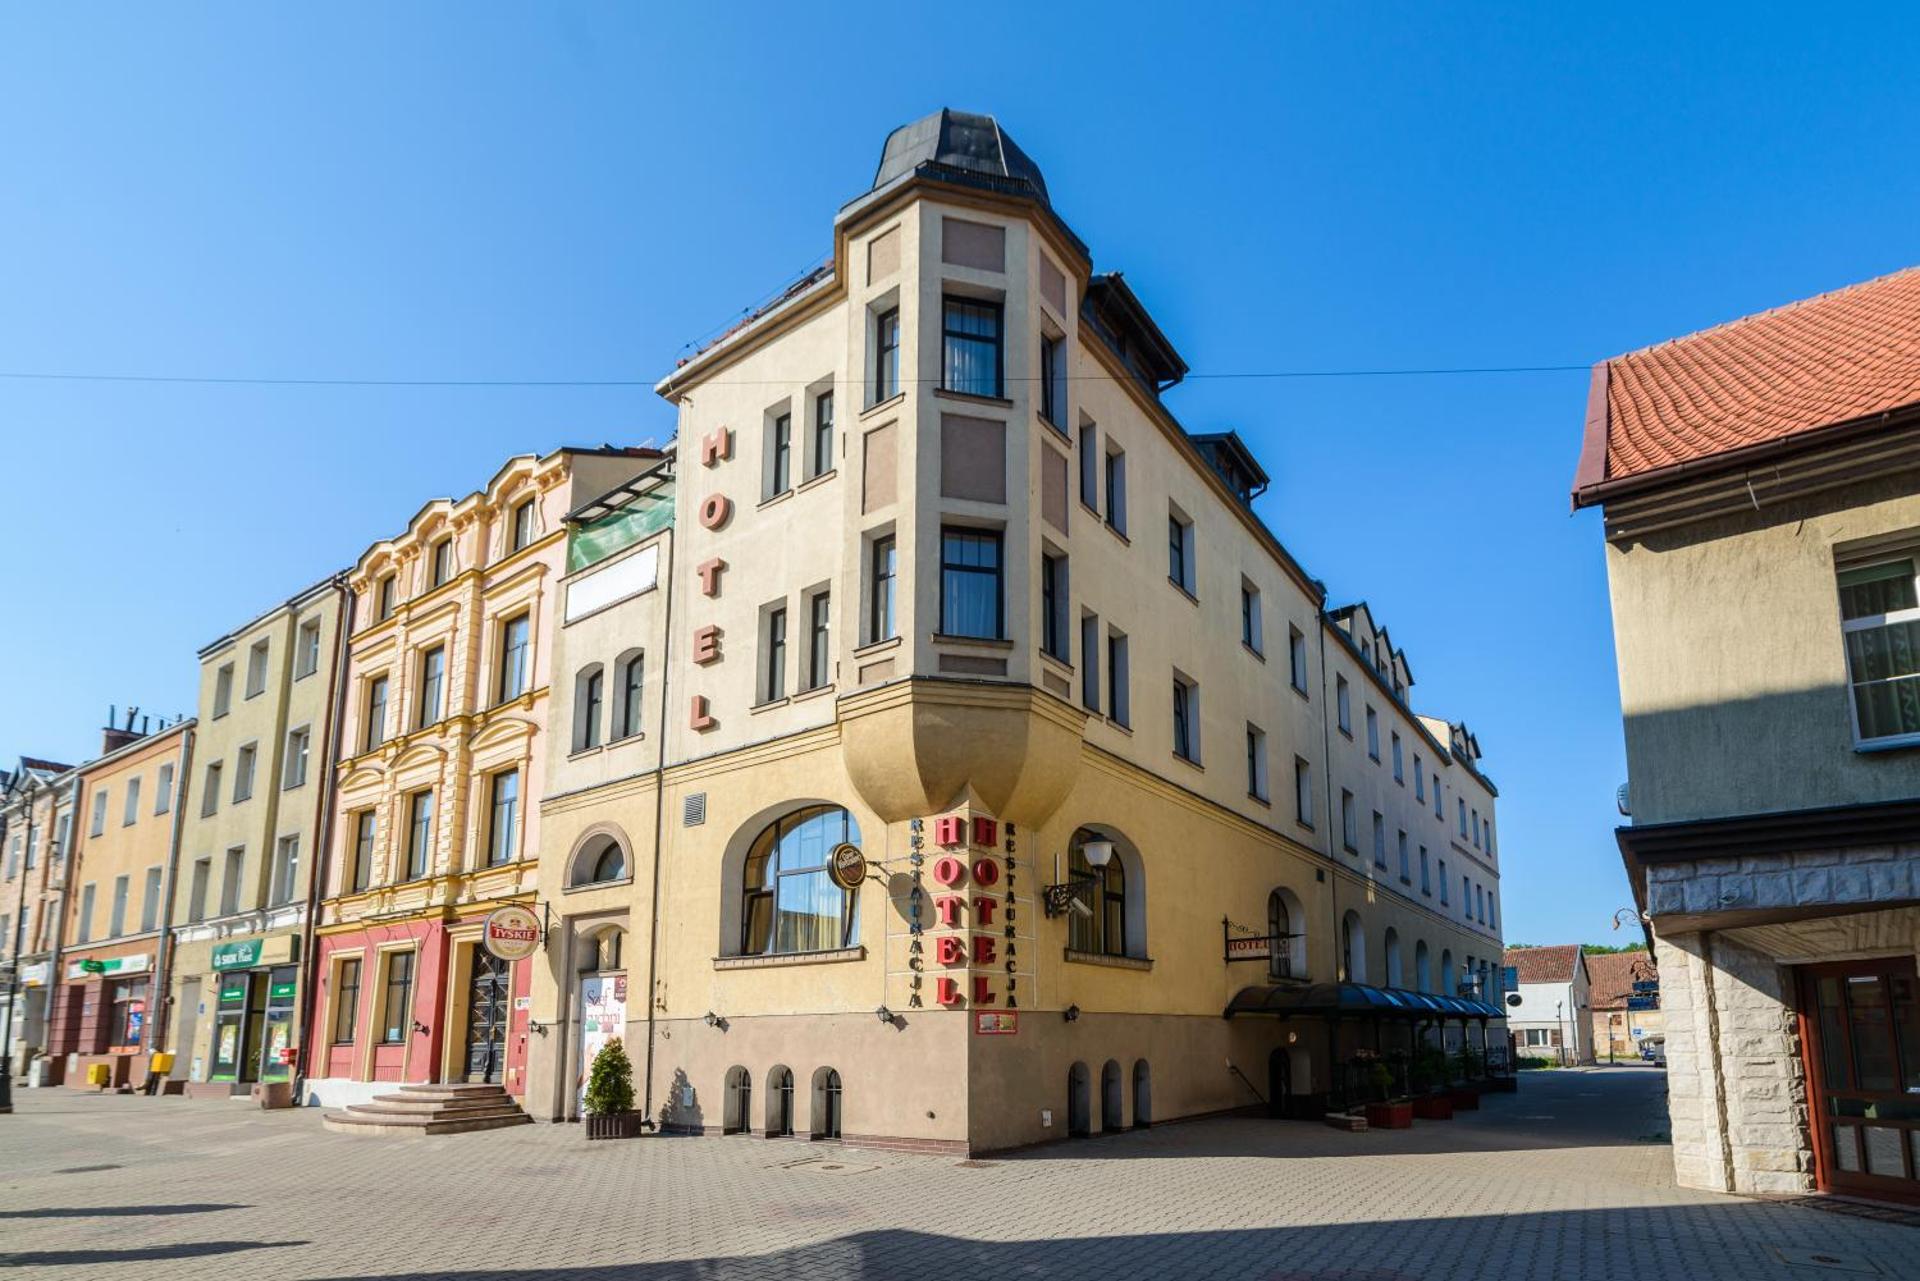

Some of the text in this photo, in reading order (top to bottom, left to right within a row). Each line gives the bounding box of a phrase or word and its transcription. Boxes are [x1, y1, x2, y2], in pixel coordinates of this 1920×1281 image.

[691, 425, 731, 735] HOTEL
[495, 927, 535, 941] TYSKIE
[909, 816, 926, 1008] RESTAURACJA
[934, 816, 963, 1006] HOTEL
[973, 816, 999, 1004] HOTEL
[1005, 821, 1017, 1008] RESTAURACJA
[1228, 938, 1269, 952] HOTEL
